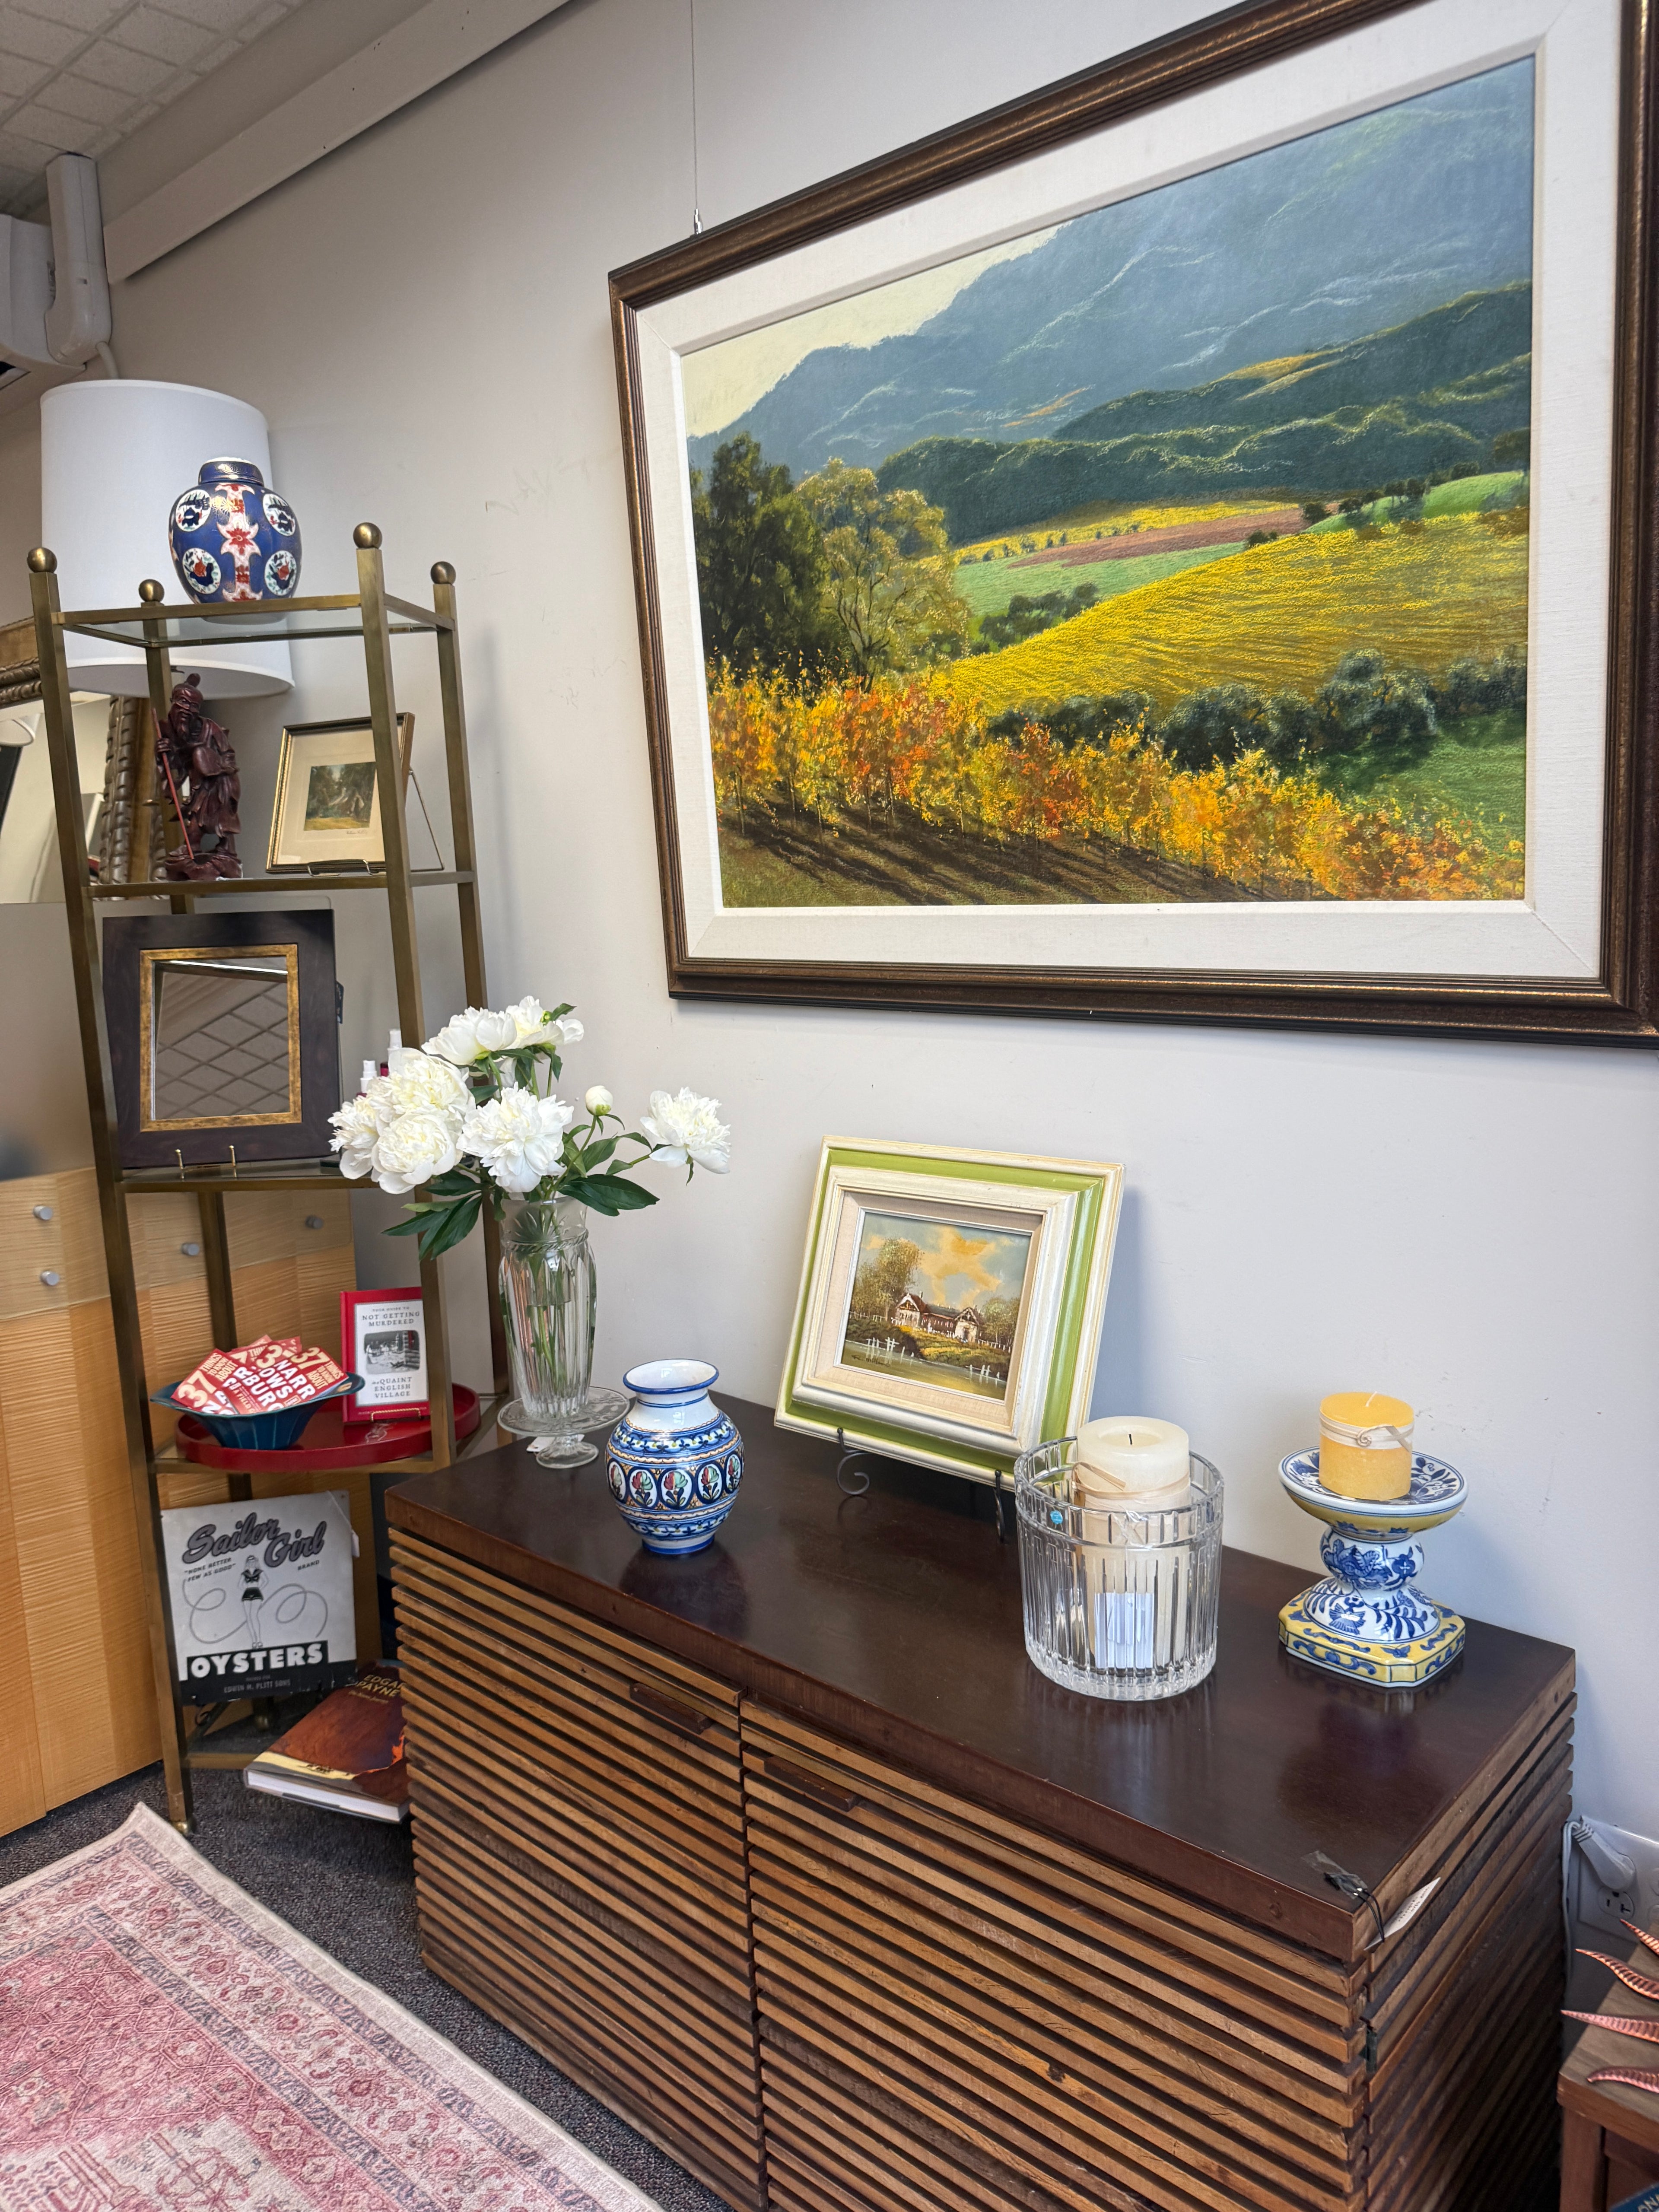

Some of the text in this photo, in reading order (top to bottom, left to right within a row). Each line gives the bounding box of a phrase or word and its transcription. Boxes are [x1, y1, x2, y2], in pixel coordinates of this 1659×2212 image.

[198, 1353, 222, 1372] THINGS
[214, 1357, 229, 1372] KNOW
[290, 1347, 331, 1369] 37
[215, 1360, 238, 1382] ABOUT
[324, 1360, 344, 1379] THINGS
[178, 1370, 217, 1407] 37
[259, 1367, 293, 1398] OWS
[273, 1360, 315, 1399] NARR
[306, 1370, 328, 1389] ABOUT
[380, 1377, 412, 1386] QUAINT
[236, 1393, 251, 1409] FIELD
[182, 1512, 280, 1564] Sailor
[264, 1521, 327, 1567] Girl
[208, 1557, 232, 1569] BETTER
[298, 1560, 320, 1570] BRAND
[187, 1574, 203, 1582] FEW
[191, 1643, 323, 1678] OYSTERS
[224, 1683, 245, 1693] EDWIN
[357, 1681, 400, 1697] PAYNE
